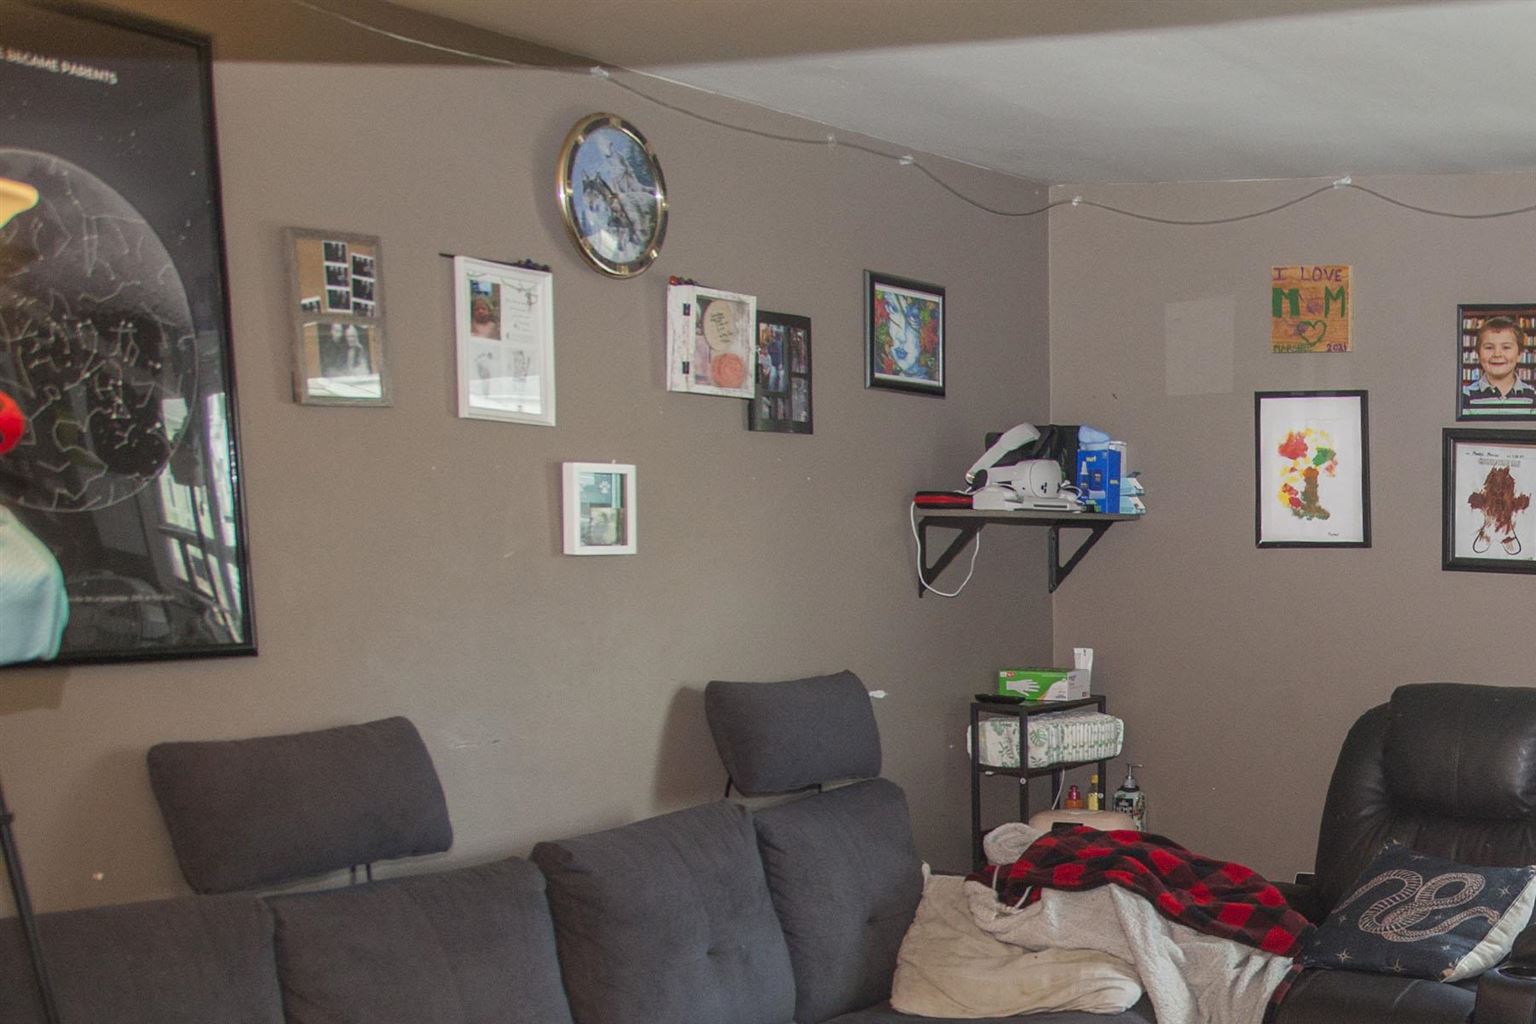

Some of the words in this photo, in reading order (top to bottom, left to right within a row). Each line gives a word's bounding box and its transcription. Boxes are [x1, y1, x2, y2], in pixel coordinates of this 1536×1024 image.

[61, 60, 118, 85] PARENTS
[1273, 267, 1288, 281] I
[1300, 266, 1343, 282] LOVE
